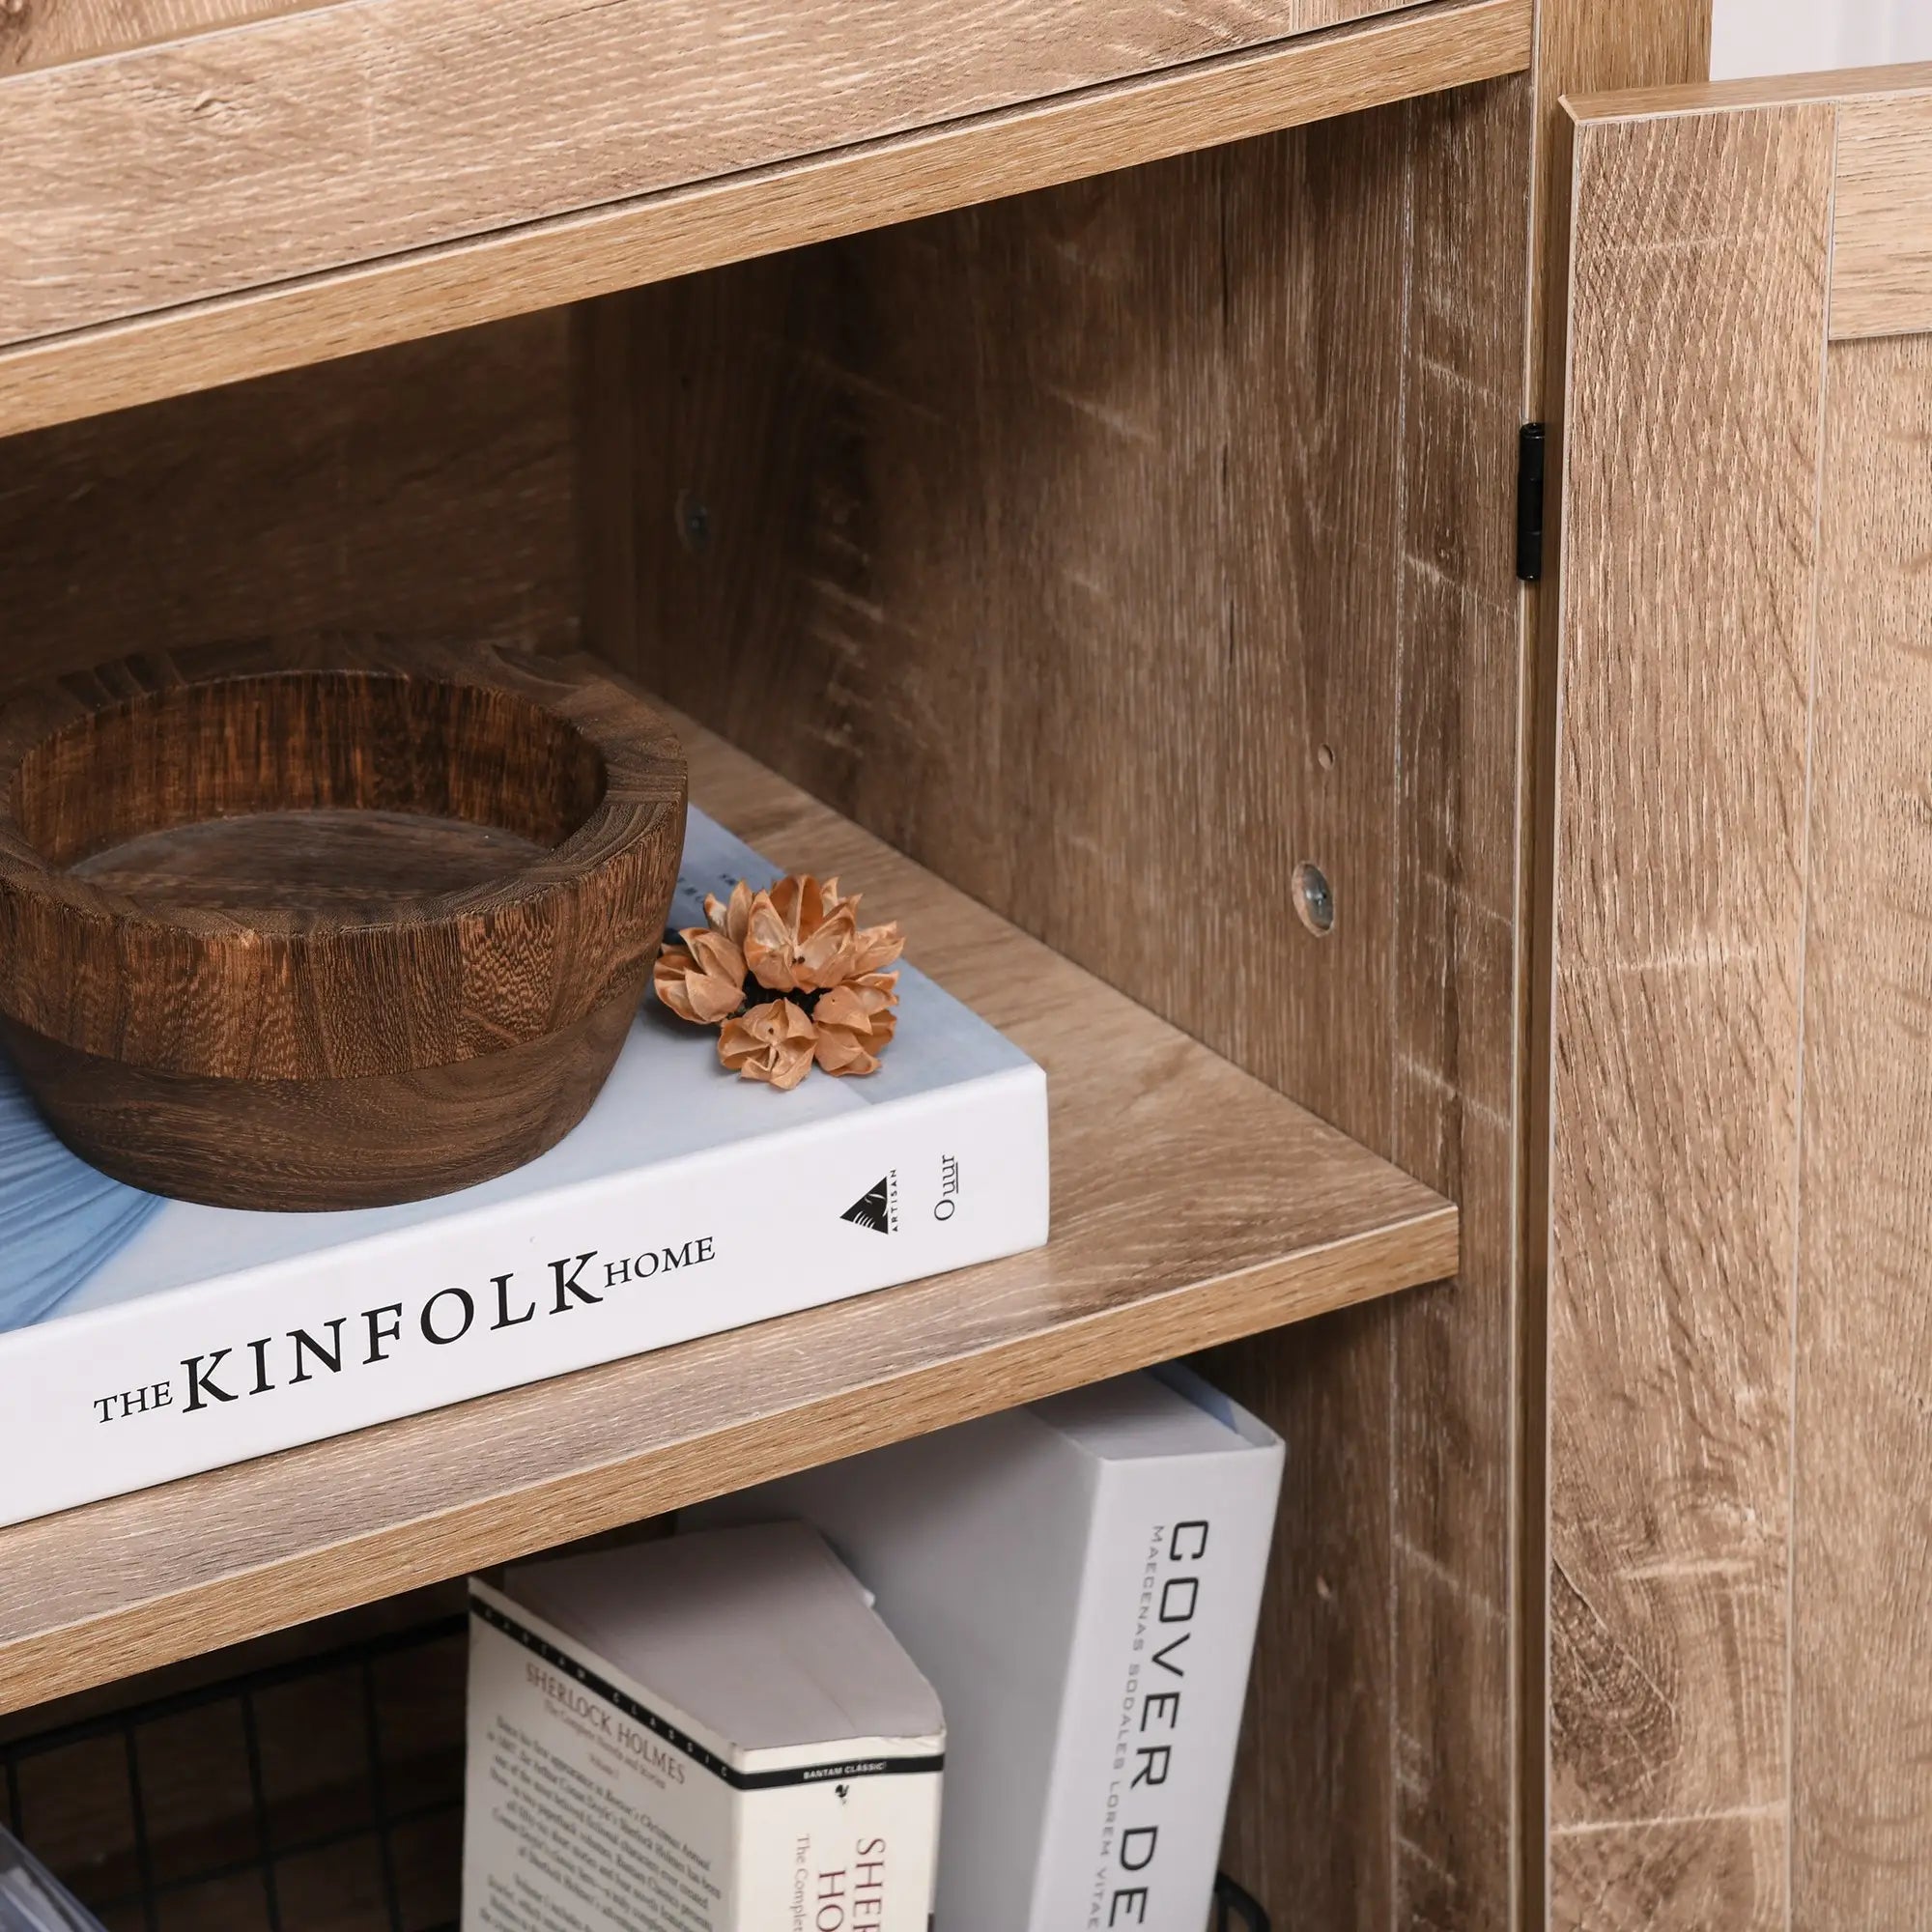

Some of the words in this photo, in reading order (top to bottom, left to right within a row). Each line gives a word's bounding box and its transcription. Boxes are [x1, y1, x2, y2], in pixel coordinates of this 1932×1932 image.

[890, 1169, 898, 1233] ARTISAN
[94, 1380, 173, 1423] THE
[181, 1251, 603, 1413] KINFOLK
[604, 1236, 716, 1288] HOME
[1132, 1524, 1165, 1652] MAECENAS
[1130, 1520, 1209, 1789] COVER
[526, 1661, 612, 1736] SHERLOCK
[617, 1722, 686, 1785] HOLMES
[803, 1766, 843, 1780] BANTAM
[796, 1833, 810, 1863] The
[1100, 1781, 1121, 1856] LOREM
[816, 1869, 846, 1932] HO
[1109, 1825, 1158, 1928] DE
